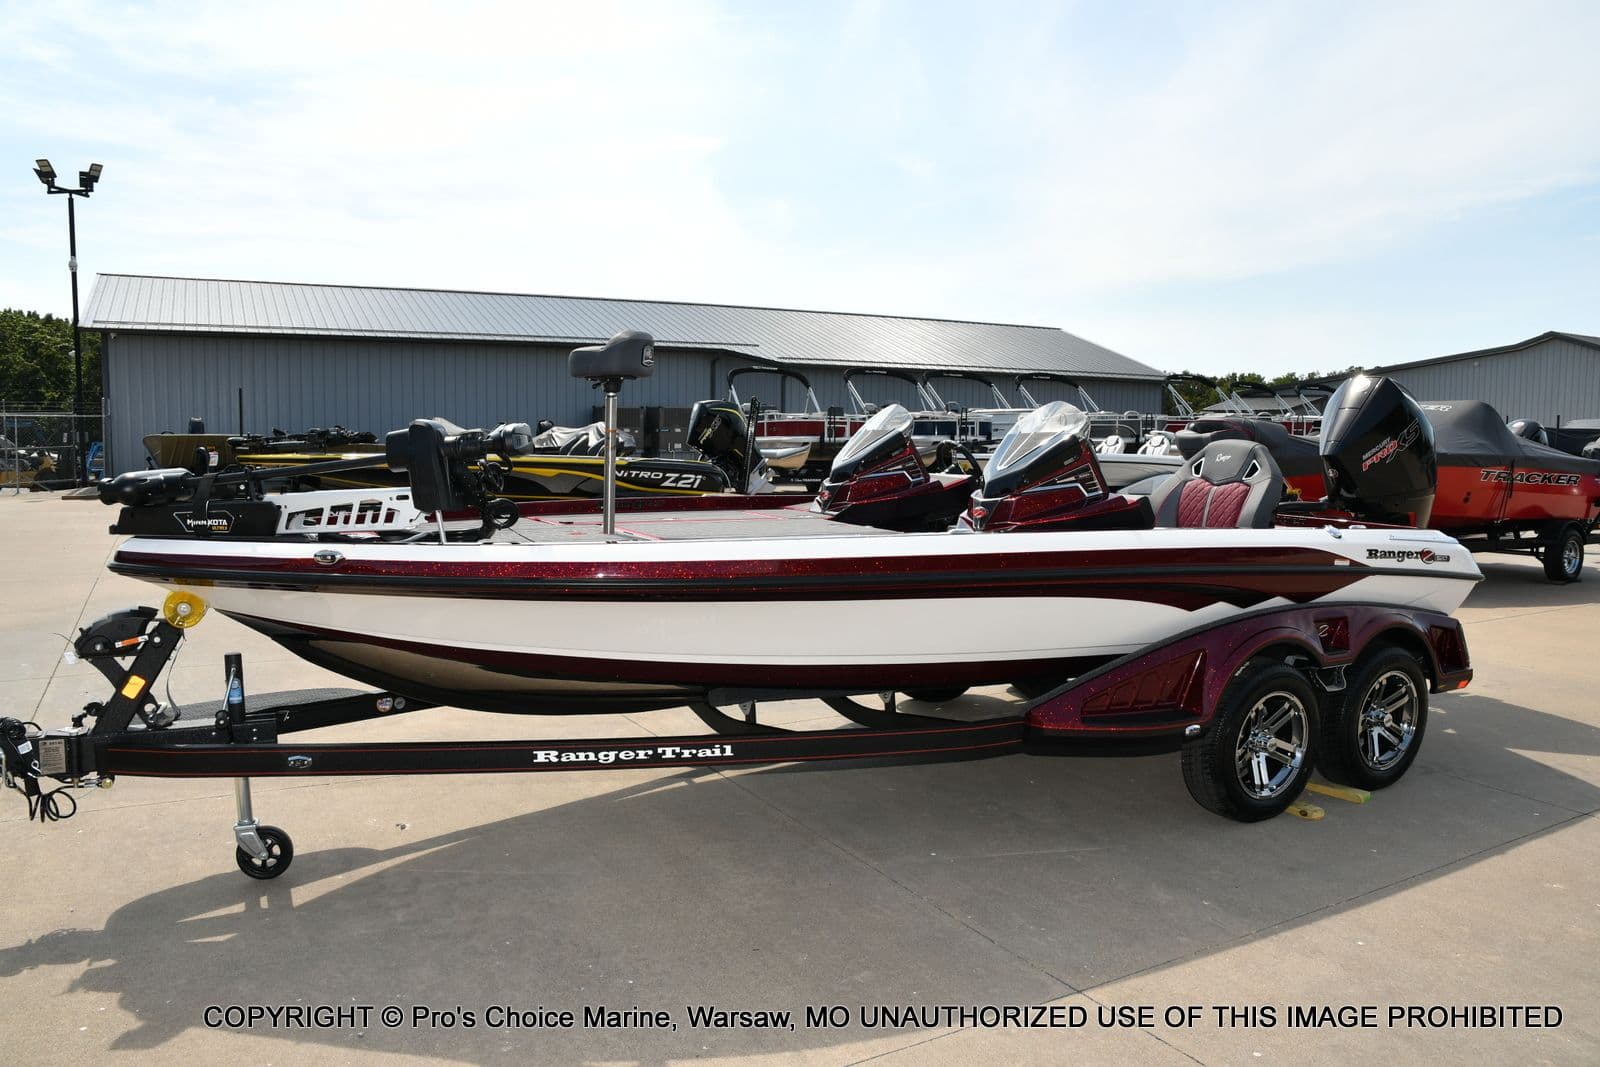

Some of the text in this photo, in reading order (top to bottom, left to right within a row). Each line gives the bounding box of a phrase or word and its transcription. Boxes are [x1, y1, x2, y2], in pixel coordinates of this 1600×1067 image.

[1362, 436, 1391, 461] MERCURY
[1362, 440, 1397, 472] PRO
[615, 470, 702, 488] NITRO Z21
[1481, 469, 1581, 486] TRACKER
[1366, 549, 1421, 562] Ranger
[533, 745, 733, 764] Ranger Trail
